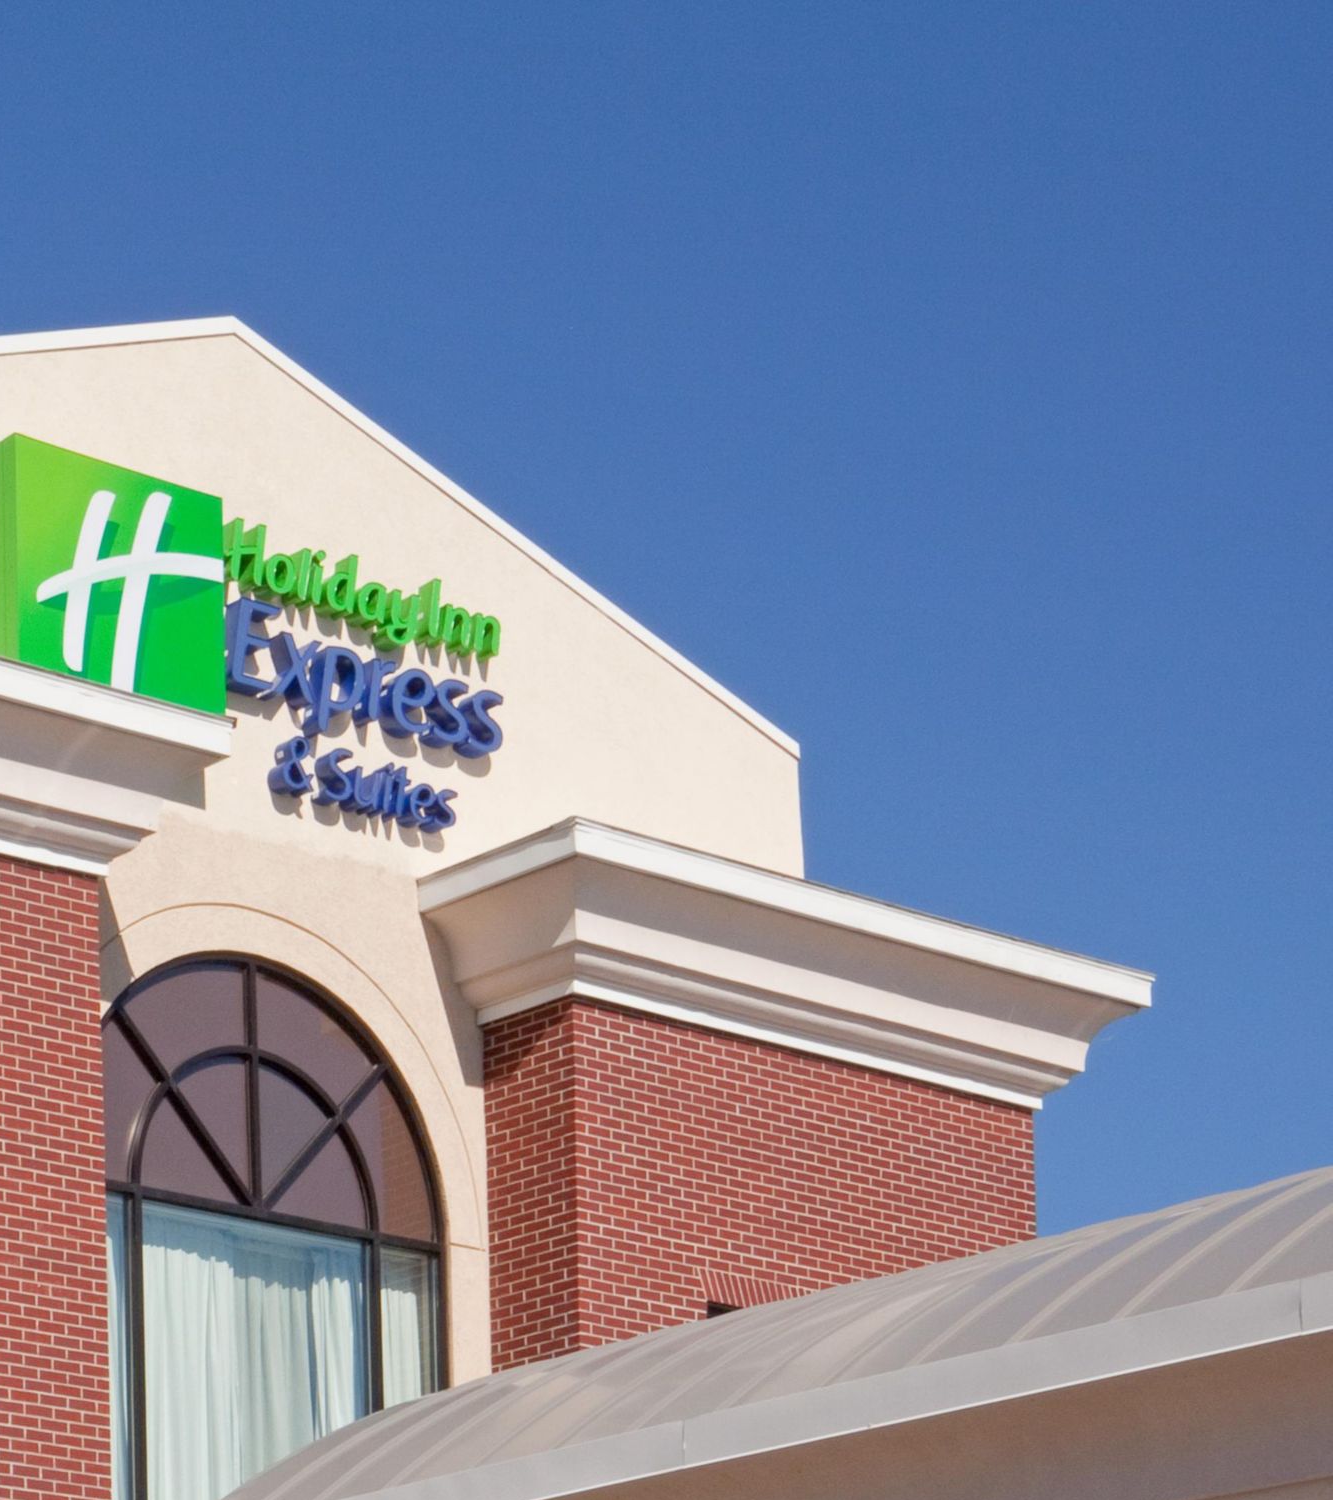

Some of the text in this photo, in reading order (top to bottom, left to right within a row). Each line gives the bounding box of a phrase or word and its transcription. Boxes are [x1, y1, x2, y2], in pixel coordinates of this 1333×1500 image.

[224, 517, 501, 659] Holiday Inn
[227, 596, 504, 759] Express
[268, 736, 457, 833] & Suites
